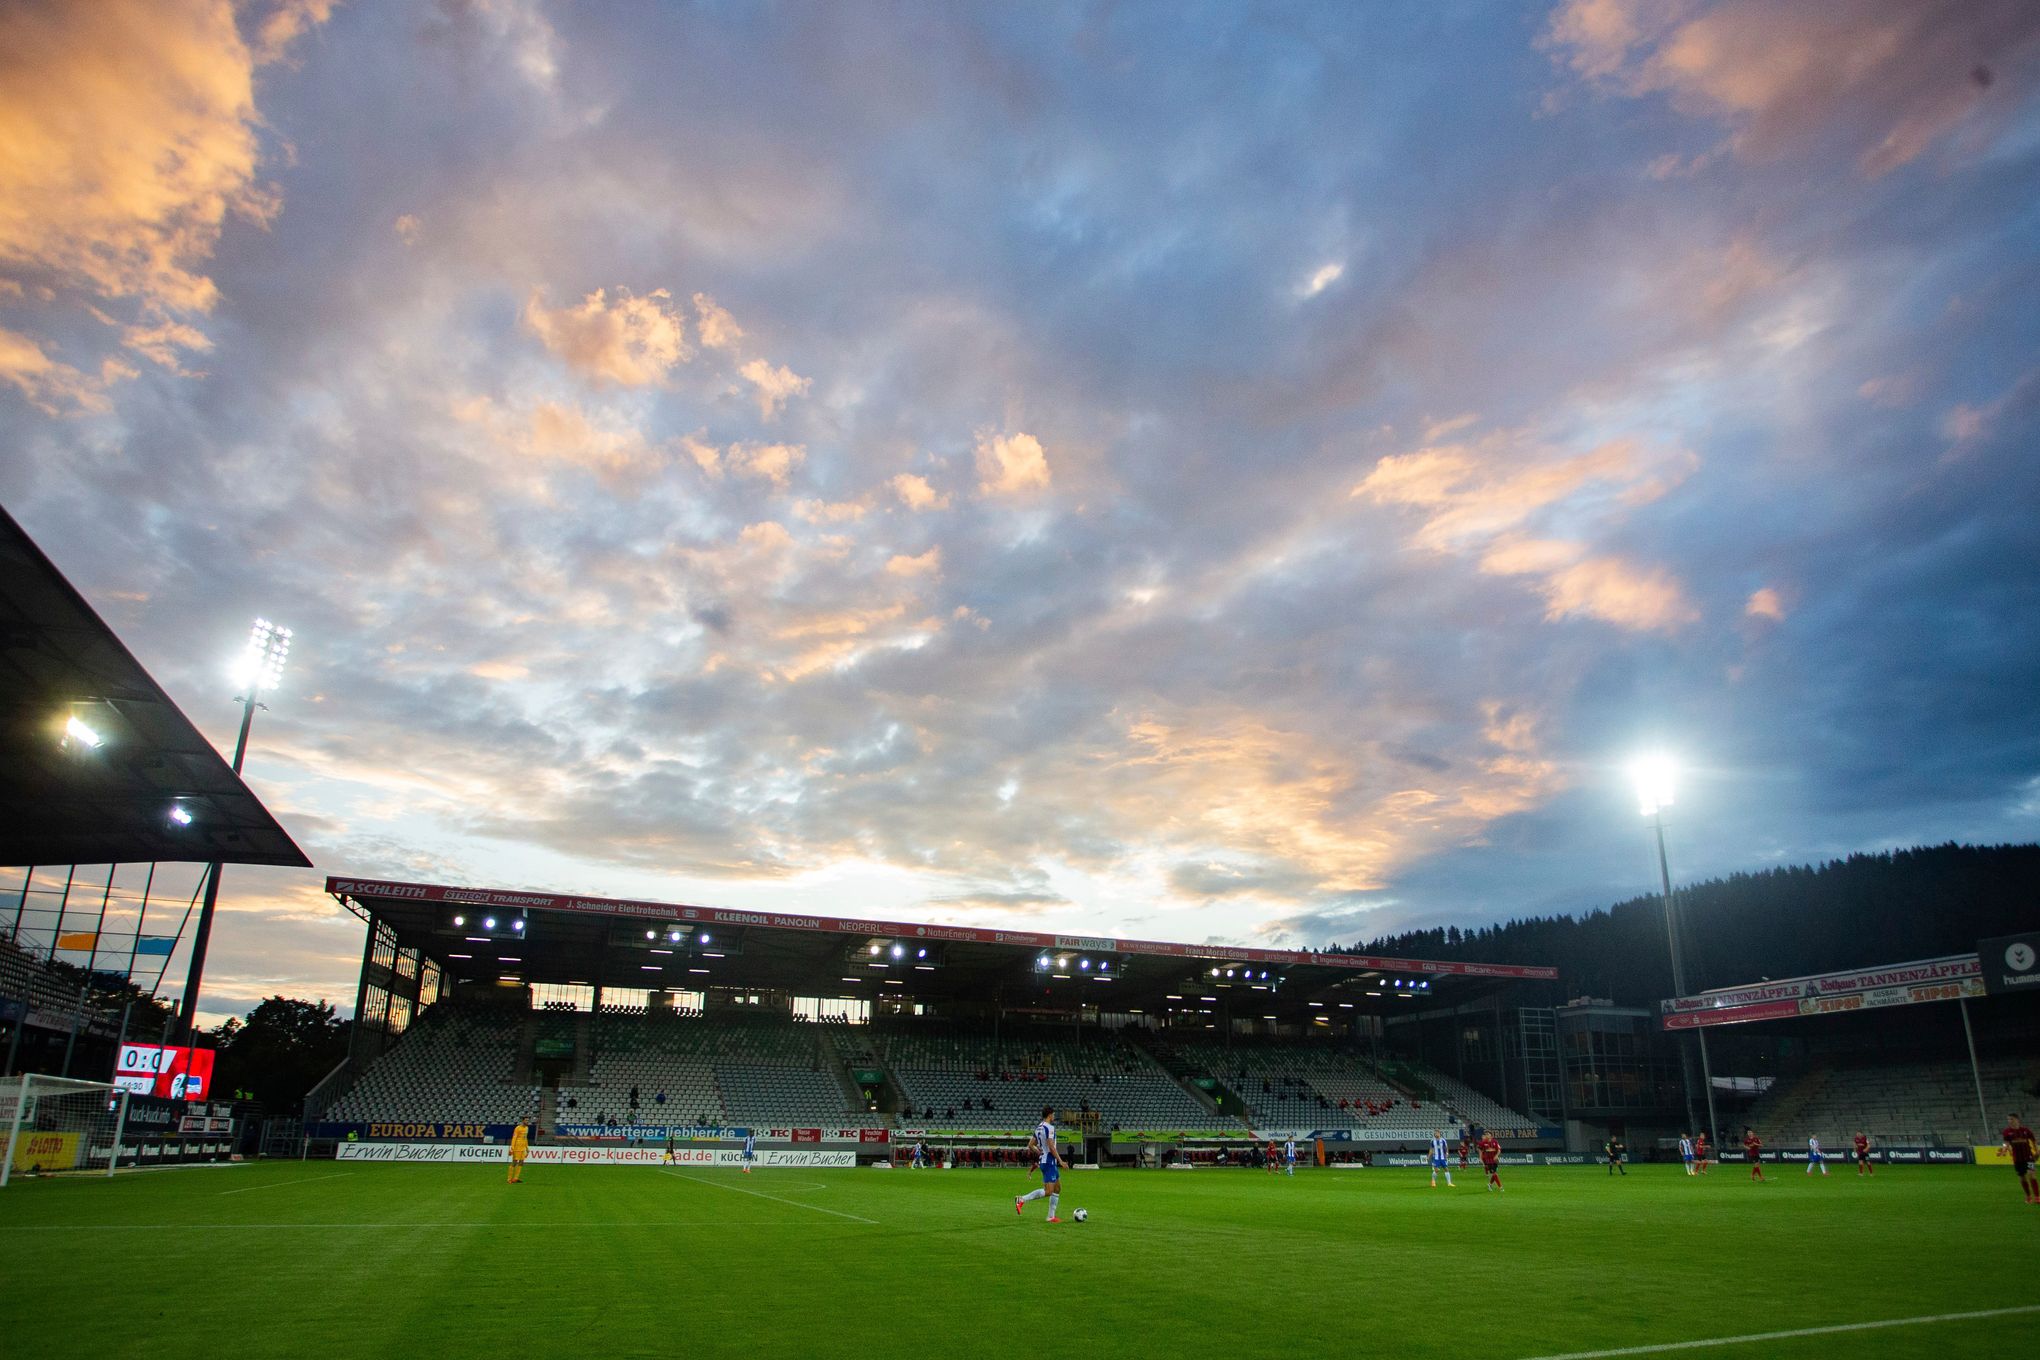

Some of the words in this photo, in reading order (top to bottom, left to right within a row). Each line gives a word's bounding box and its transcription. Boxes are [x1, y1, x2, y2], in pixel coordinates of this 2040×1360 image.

[355, 882, 426, 898] SCHLEITH
[493, 894, 554, 906] TRANSPORT
[567, 900, 574, 909] J.
[576, 901, 616, 913] Schneider
[618, 904, 678, 917] Elektrotechnik
[715, 912, 768, 924] KLEENOIL
[775, 916, 819, 928] PANOLIN
[839, 921, 882, 933] NEOPERL
[928, 928, 976, 940] NaturEnergie
[1859, 962, 1981, 988] TANNENZÄPFLE
[370, 1123, 437, 1139] EUROPA
[443, 1123, 486, 1139] PARK
[567, 1126, 735, 1139] www.ketterer-liebherr.de
[821, 1130, 858, 1138] ISOTEC
[1364, 1131, 1449, 1139] GESUNDHEITSRESRT
[340, 1143, 396, 1159] Erwin
[395, 1144, 452, 1159] Bucher
[460, 1147, 502, 1158] KÜCHEN
[528, 1147, 712, 1163] ww.regio-kueche-ad.de
[721, 1151, 758, 1162] KÜCHN
[767, 1151, 808, 1165] Erwin
[810, 1152, 854, 1166] Bucher
[1389, 1157, 1420, 1165] Waldmann
